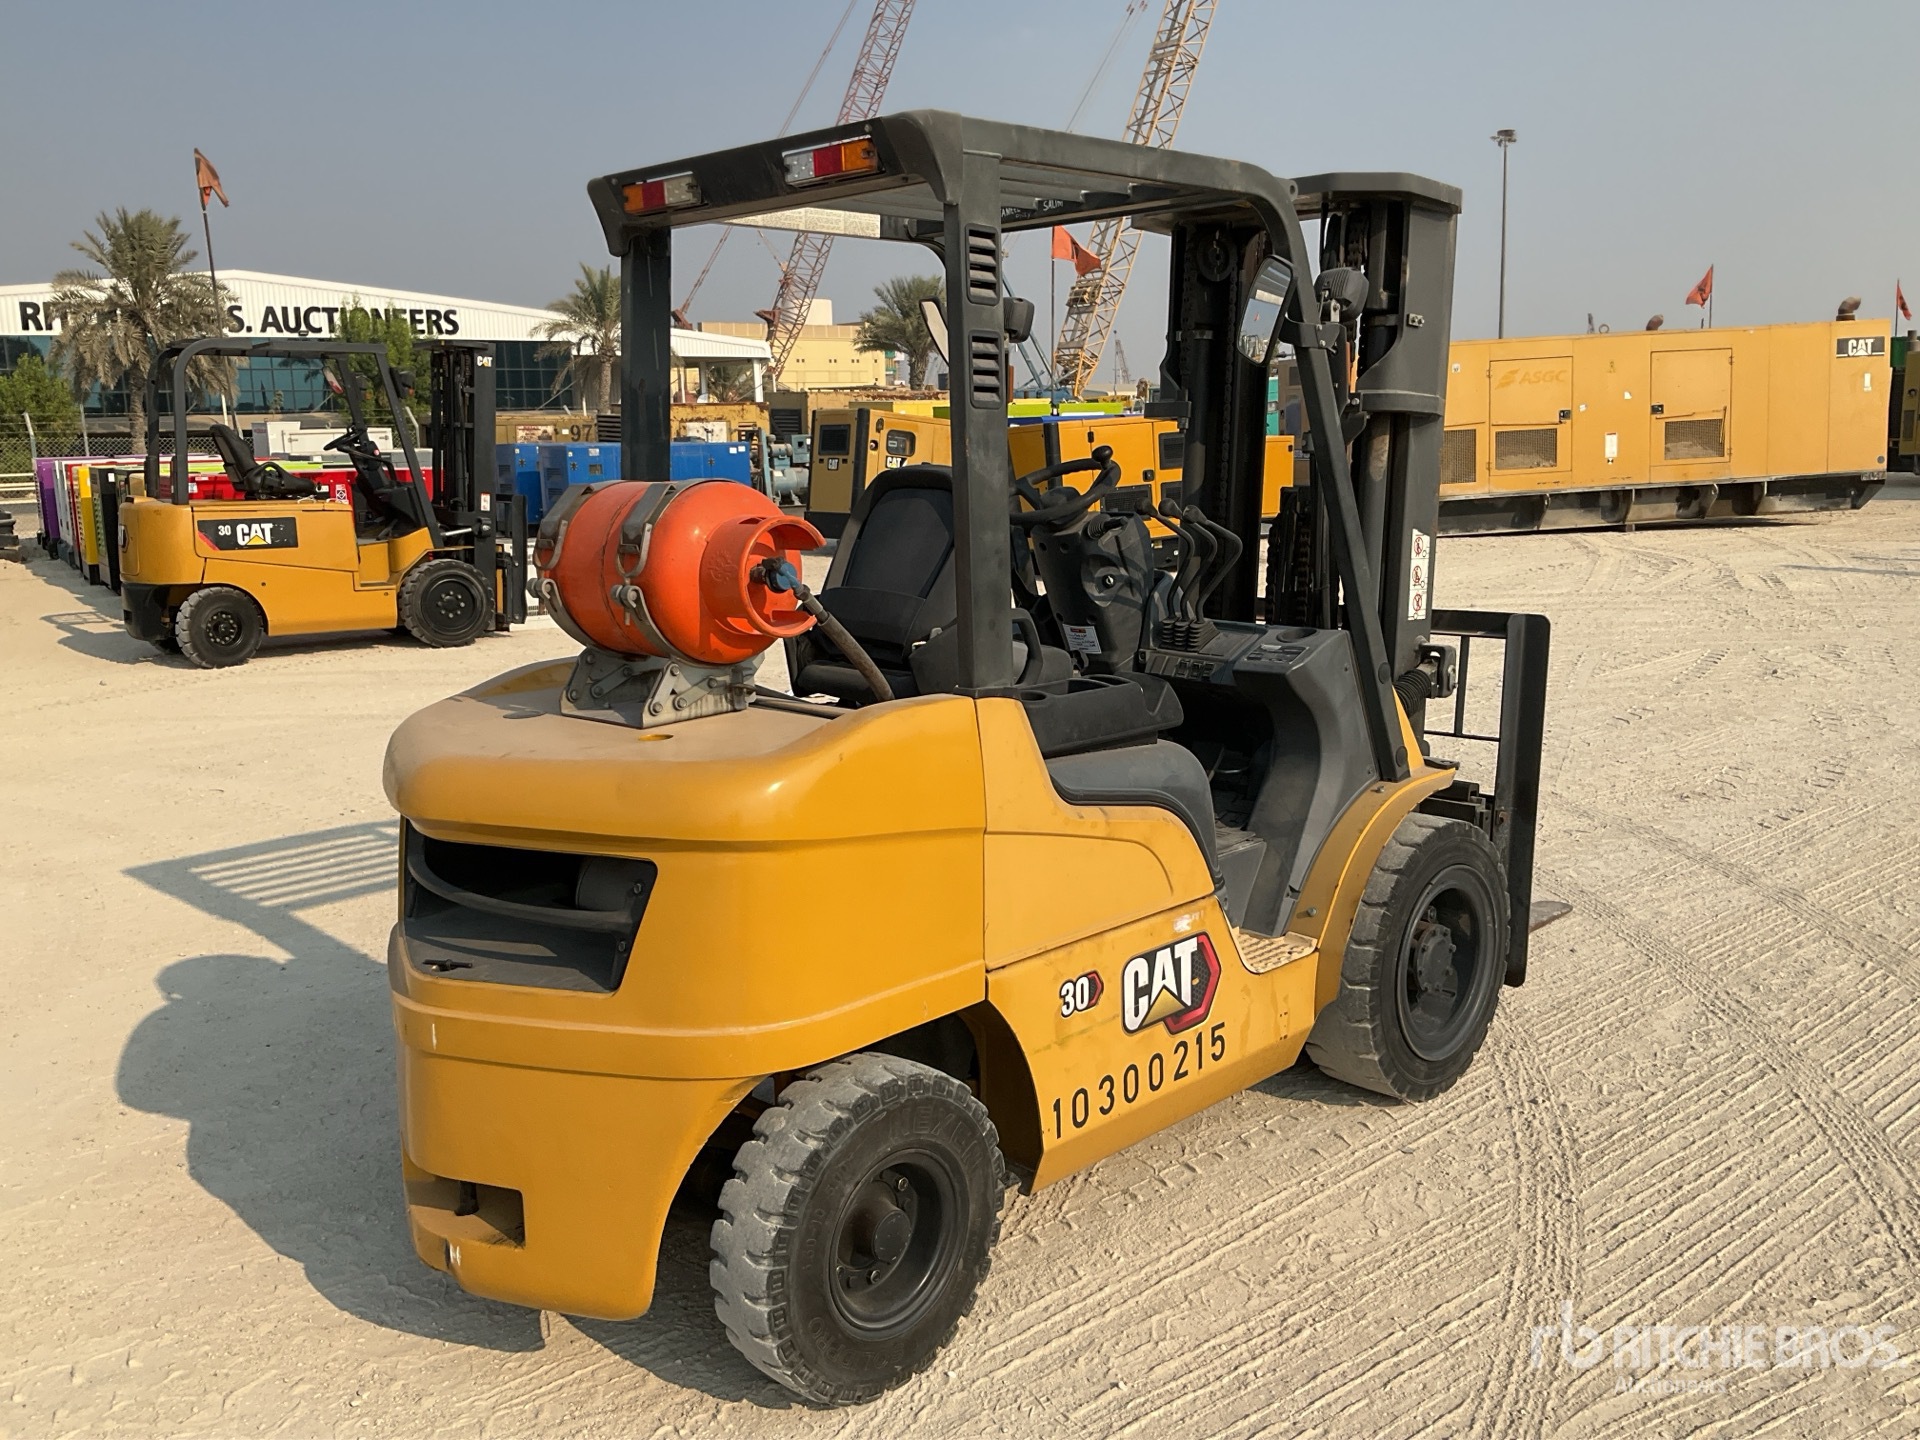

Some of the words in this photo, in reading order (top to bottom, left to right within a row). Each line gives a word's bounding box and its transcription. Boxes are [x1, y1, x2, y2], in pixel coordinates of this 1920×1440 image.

[1848, 338, 1875, 356] CAT
[477, 355, 492, 367] CAT
[1519, 370, 1567, 384] ASGC
[570, 424, 592, 442] 97
[828, 459, 838, 470] CAT
[887, 457, 901, 469] CAT
[218, 525, 231, 536] 30
[236, 523, 273, 546] CAT
[1123, 936, 1198, 1032] CAT
[1060, 976, 1090, 1017] 30
[1052, 1022, 1226, 1139] 10300215
